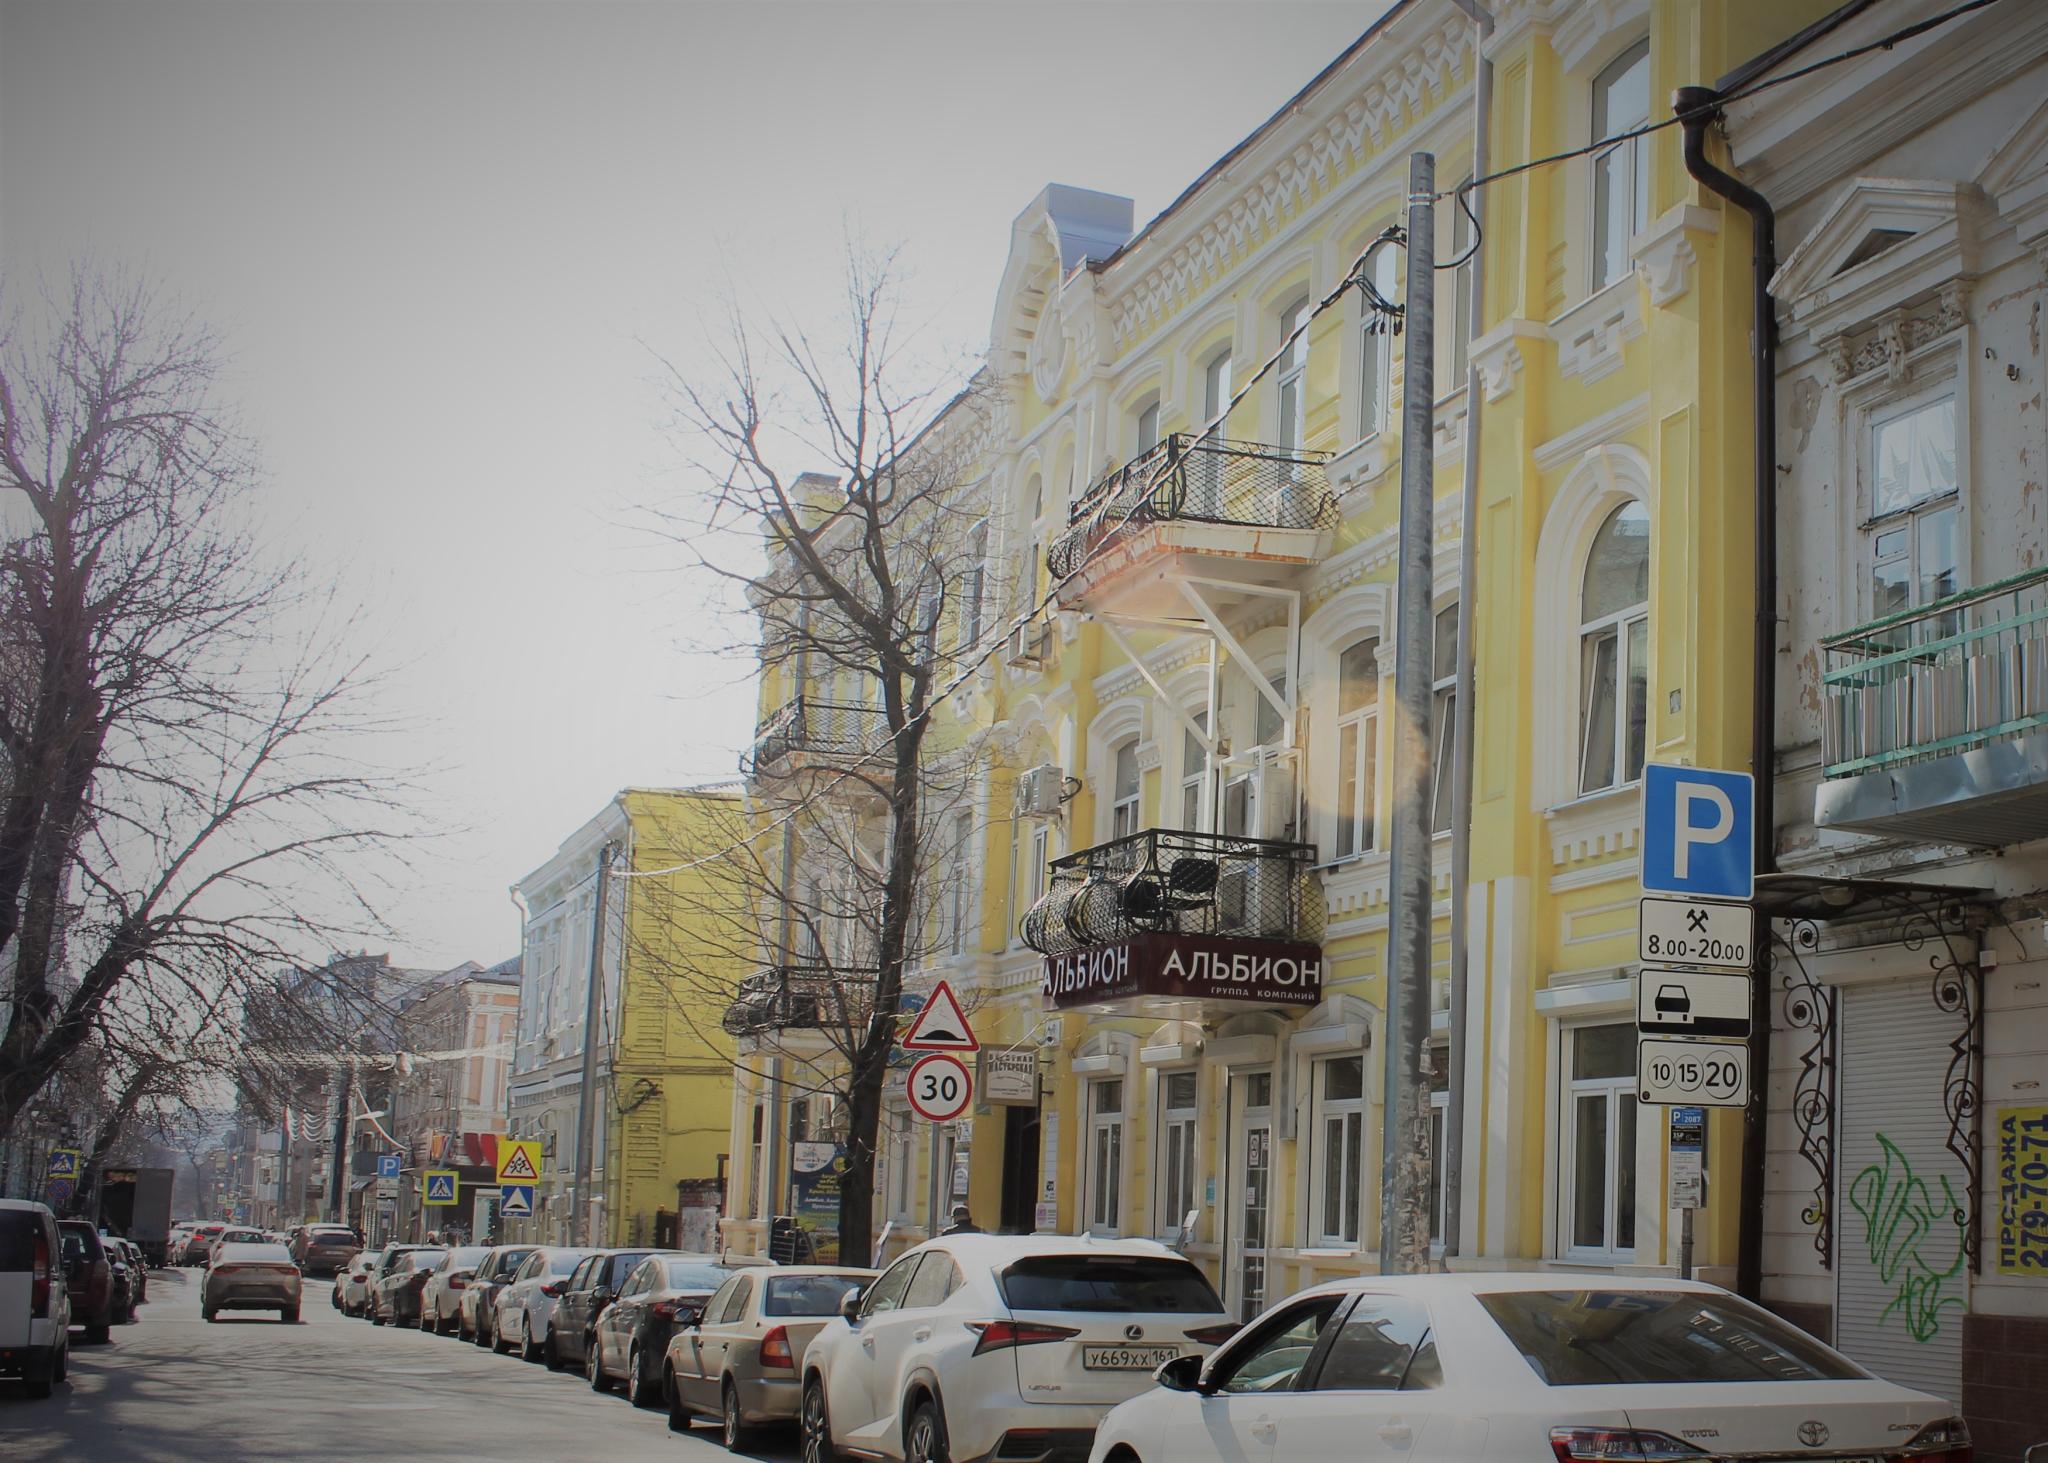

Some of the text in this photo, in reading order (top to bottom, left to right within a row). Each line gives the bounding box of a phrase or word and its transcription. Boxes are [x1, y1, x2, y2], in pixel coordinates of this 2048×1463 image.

[1673, 781, 1734, 879] P
[1648, 934, 1745, 961] 8.00-20.00
[1042, 944, 1129, 998] АЛЬБИОН
[1162, 949, 1320, 986] АЛЬБИОН
[1211, 986, 1315, 1001] ГРУППА КОМПАНИЙ
[921, 1074, 958, 1102] 30
[1652, 1061, 1738, 1088] 10 15 20
[1673, 1111, 1681, 1122] P
[384, 1158, 396, 1175] P
[2020, 1113, 2048, 1268] 279-70-71
